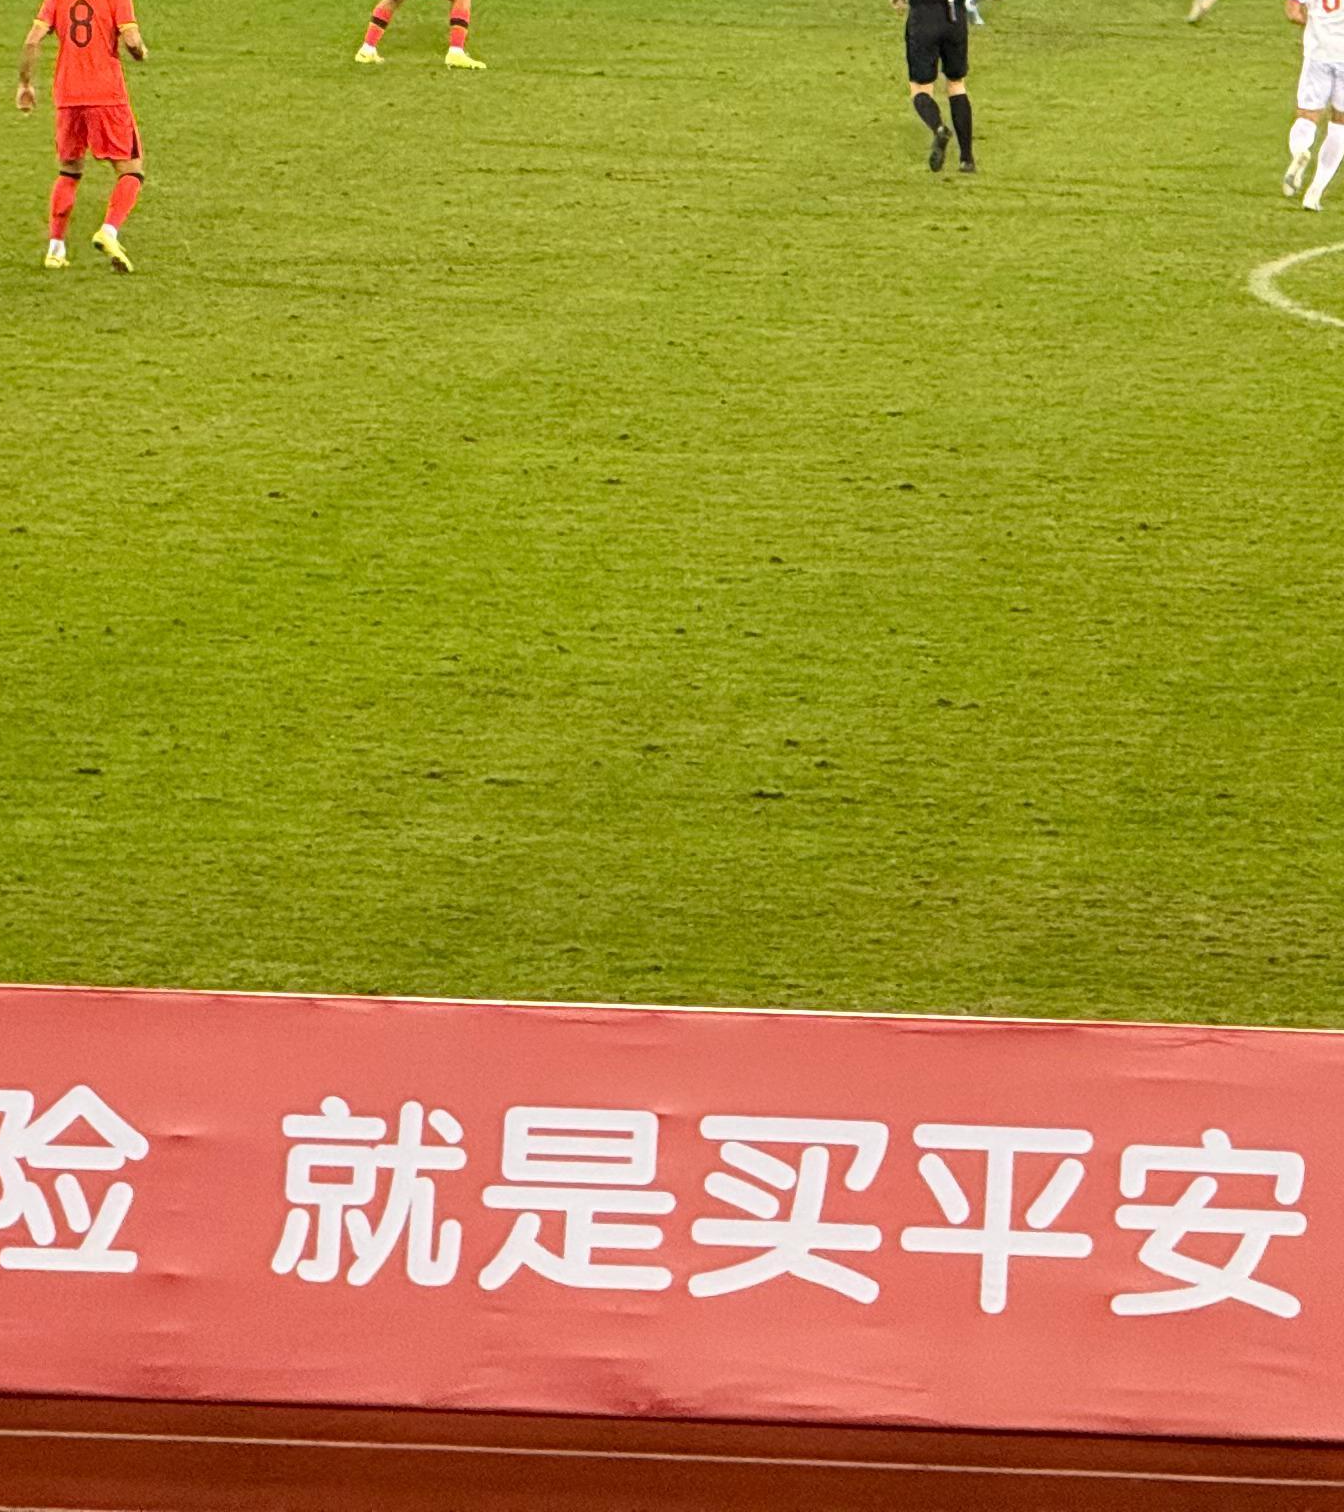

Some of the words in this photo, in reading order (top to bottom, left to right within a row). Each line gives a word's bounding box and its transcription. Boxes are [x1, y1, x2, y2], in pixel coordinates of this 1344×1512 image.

[269, 1094, 1308, 1320] 就是买平安
